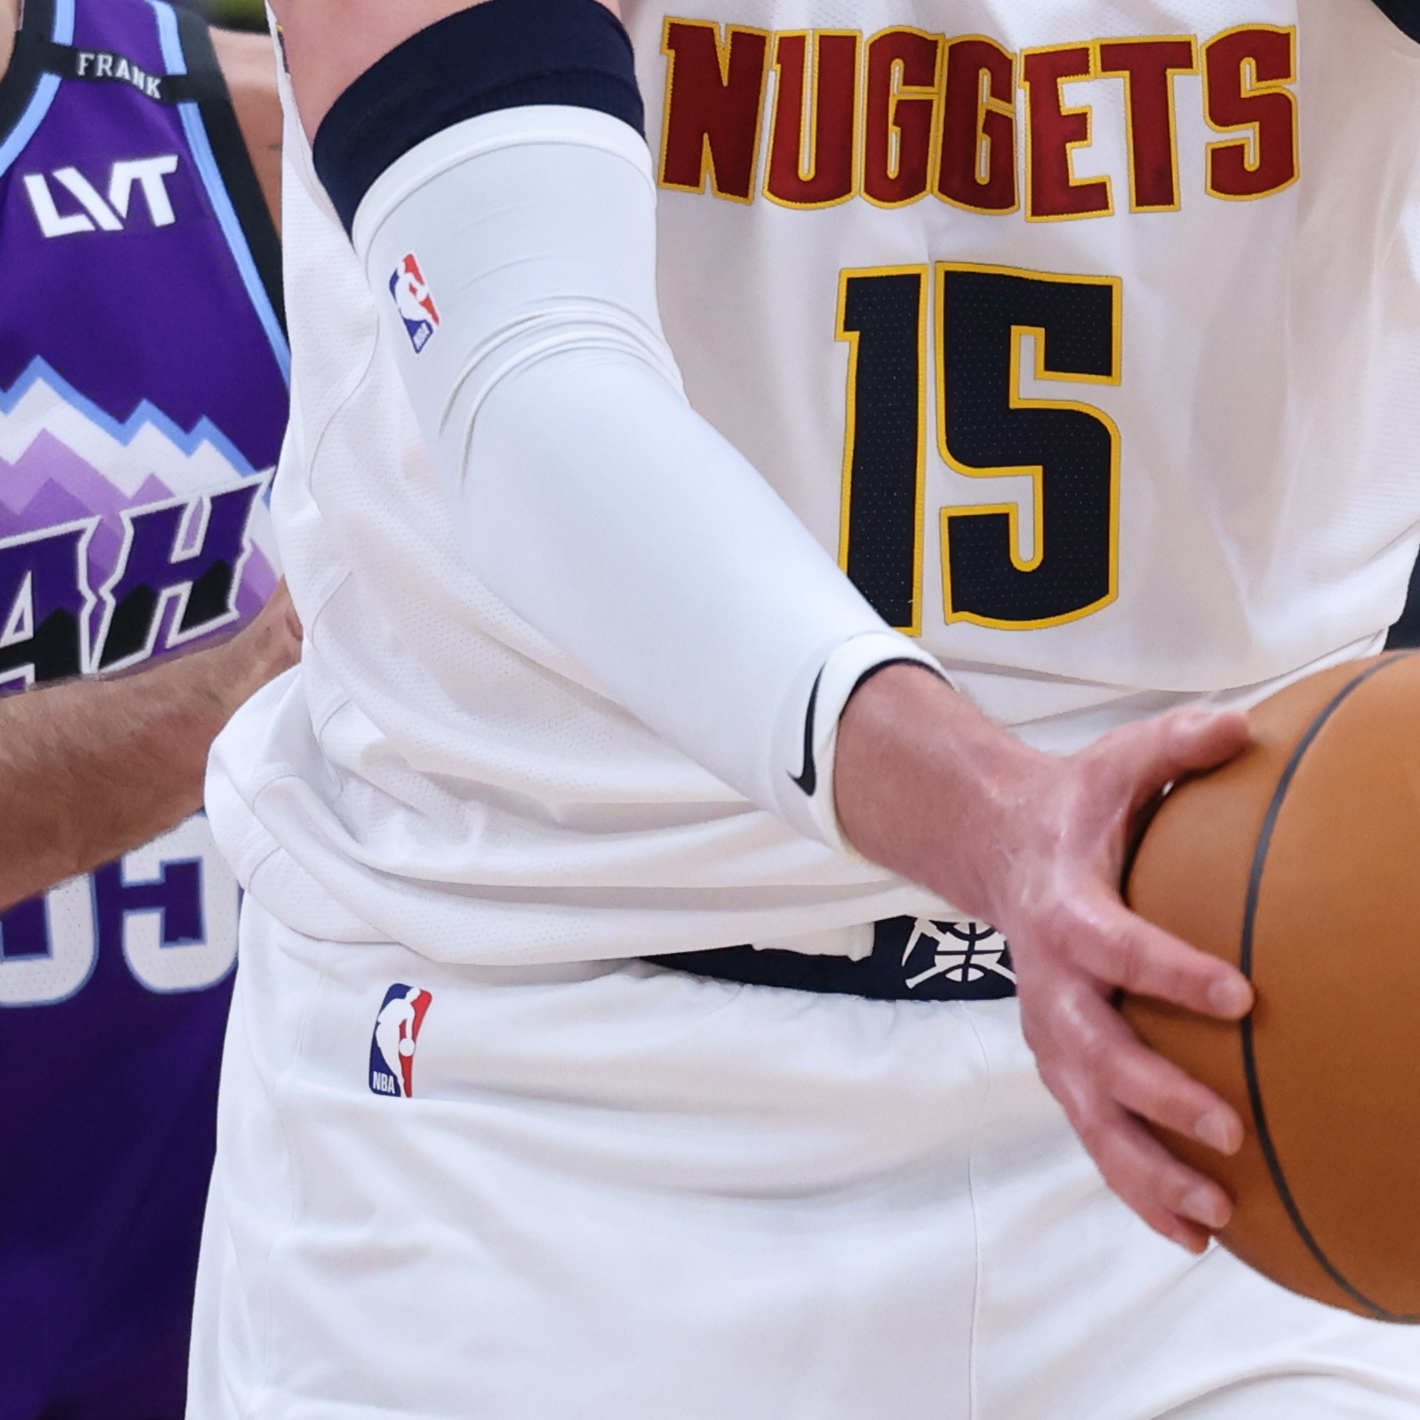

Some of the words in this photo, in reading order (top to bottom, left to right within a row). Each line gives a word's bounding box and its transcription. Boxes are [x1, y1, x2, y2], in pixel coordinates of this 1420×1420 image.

[77, 52, 162, 99] FRANK
[660, 16, 1301, 223] NUGGETS
[23, 154, 178, 239] LVT
[836, 261, 1123, 638] 15
[372, 1070, 396, 1095] NBA
